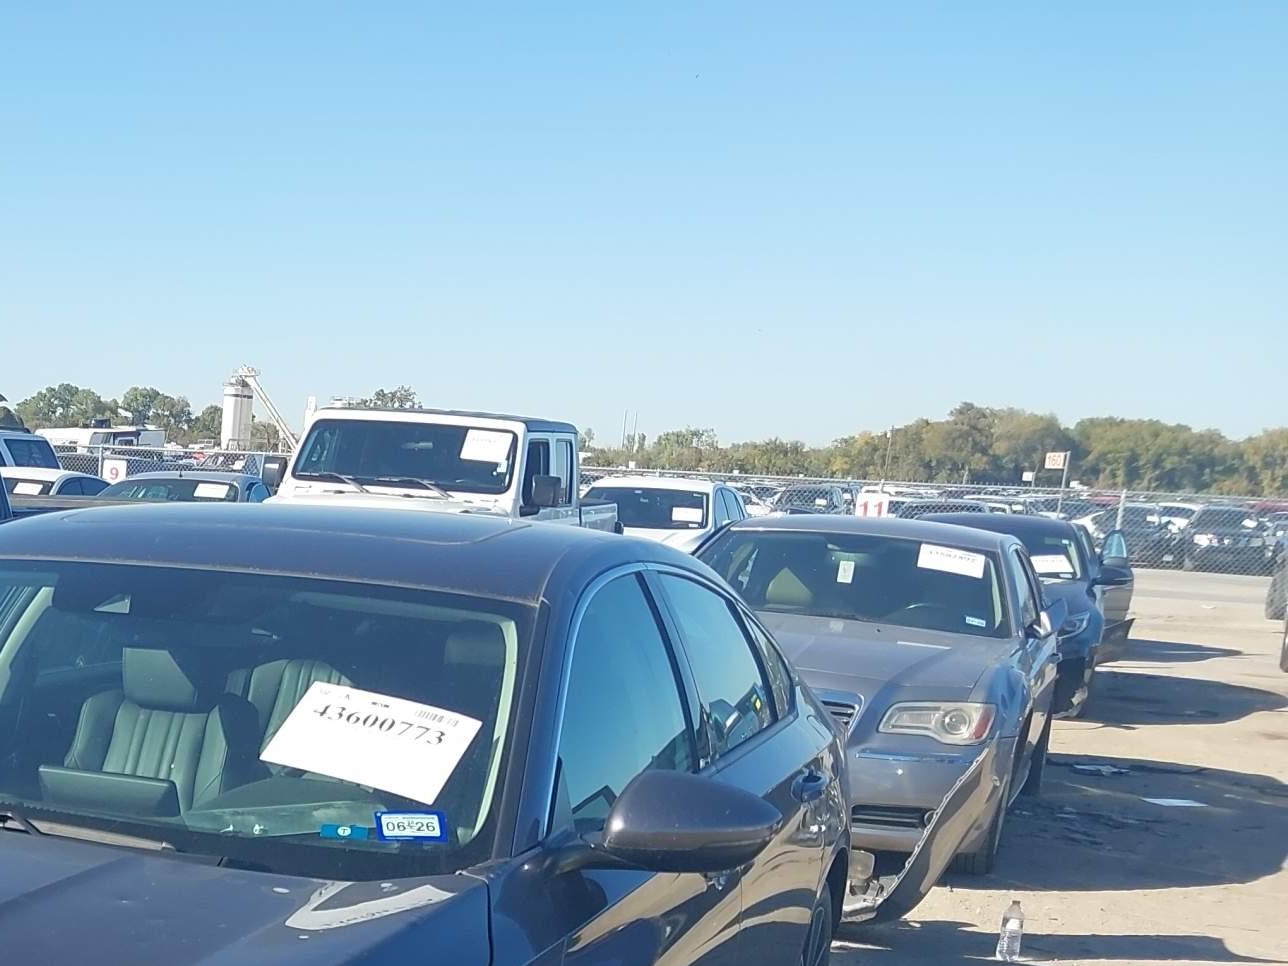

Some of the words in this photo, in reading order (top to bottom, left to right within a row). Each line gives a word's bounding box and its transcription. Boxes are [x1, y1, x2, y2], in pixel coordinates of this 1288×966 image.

[109, 467, 119, 480] 9
[859, 500, 883, 517] 11
[313, 703, 446, 745] 43600773
